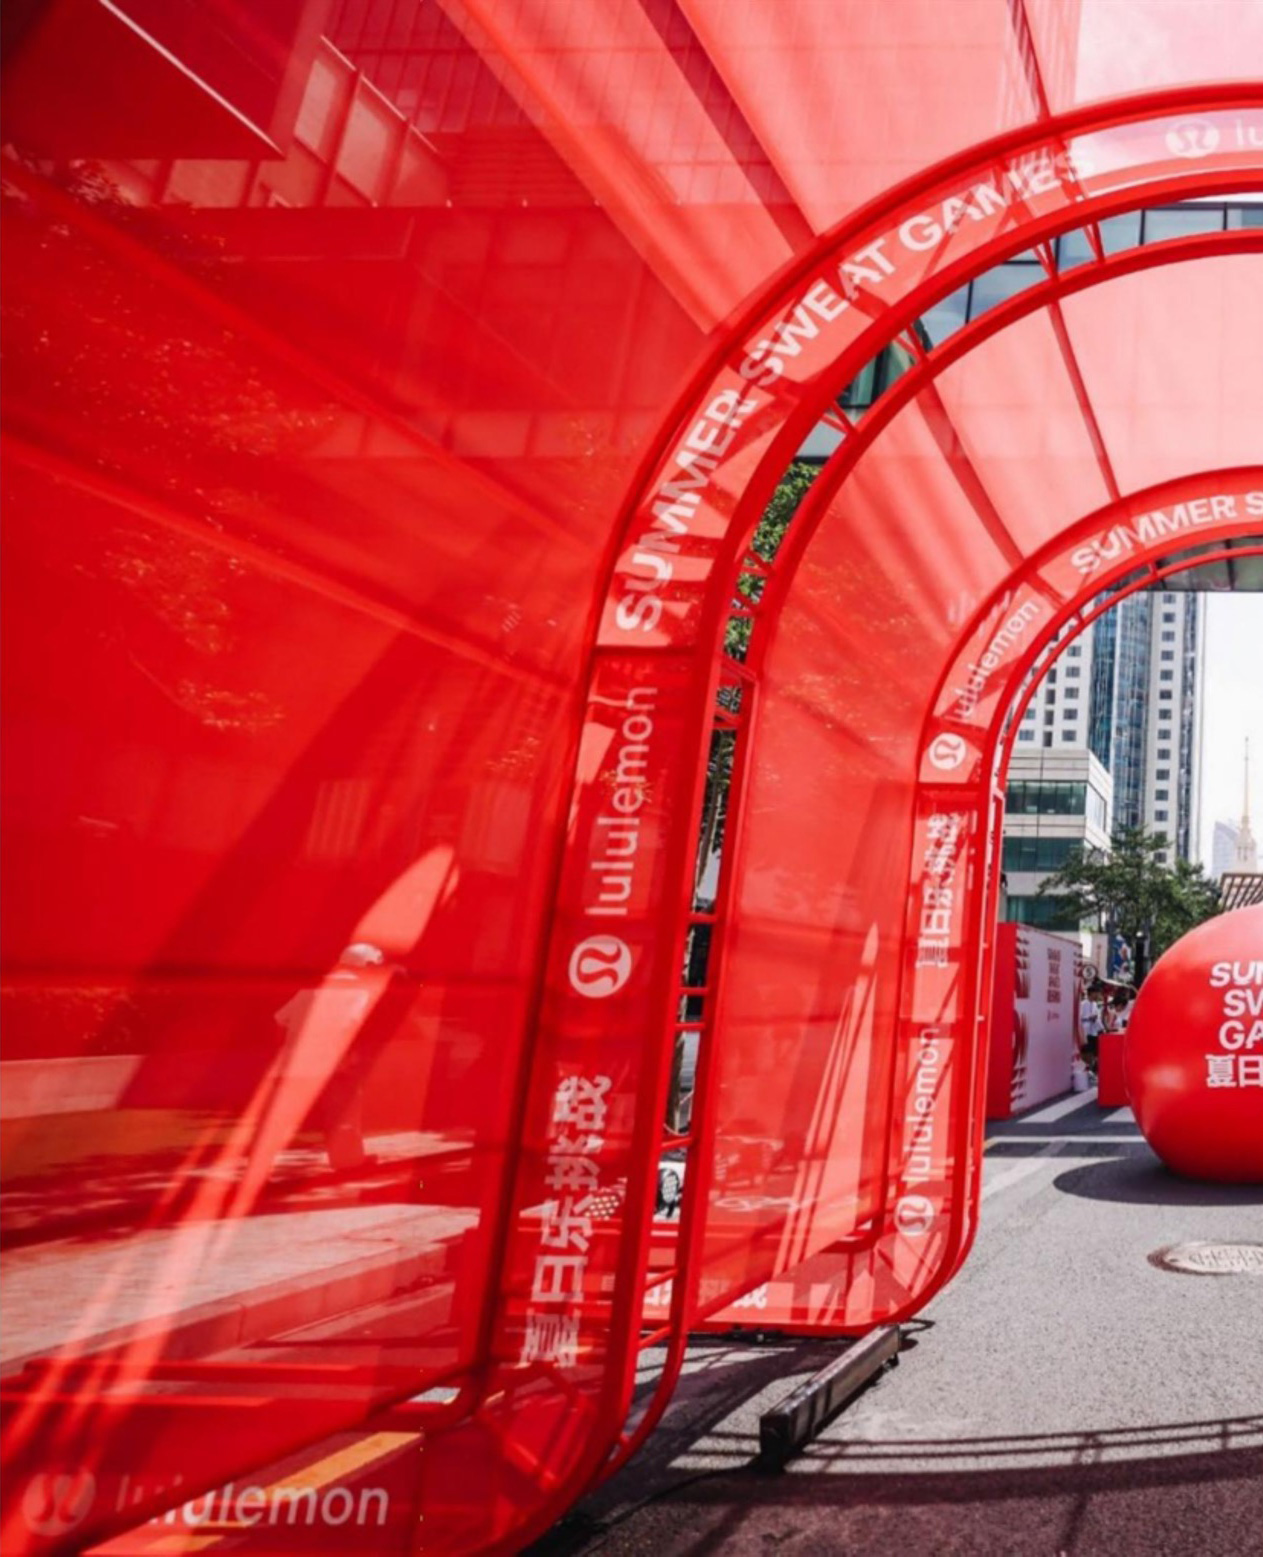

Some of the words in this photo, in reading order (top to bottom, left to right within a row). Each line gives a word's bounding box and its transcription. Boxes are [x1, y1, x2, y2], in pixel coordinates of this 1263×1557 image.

[615, 389, 757, 632] SUMMER
[739, 239, 897, 387] SWEAT
[899, 149, 1094, 252] GAMES
[1071, 498, 1236, 575] SUMMER
[584, 687, 658, 915] lululemon
[902, 1028, 939, 1183] lululemon
[519, 1076, 611, 1368] 夏日乐挑战
